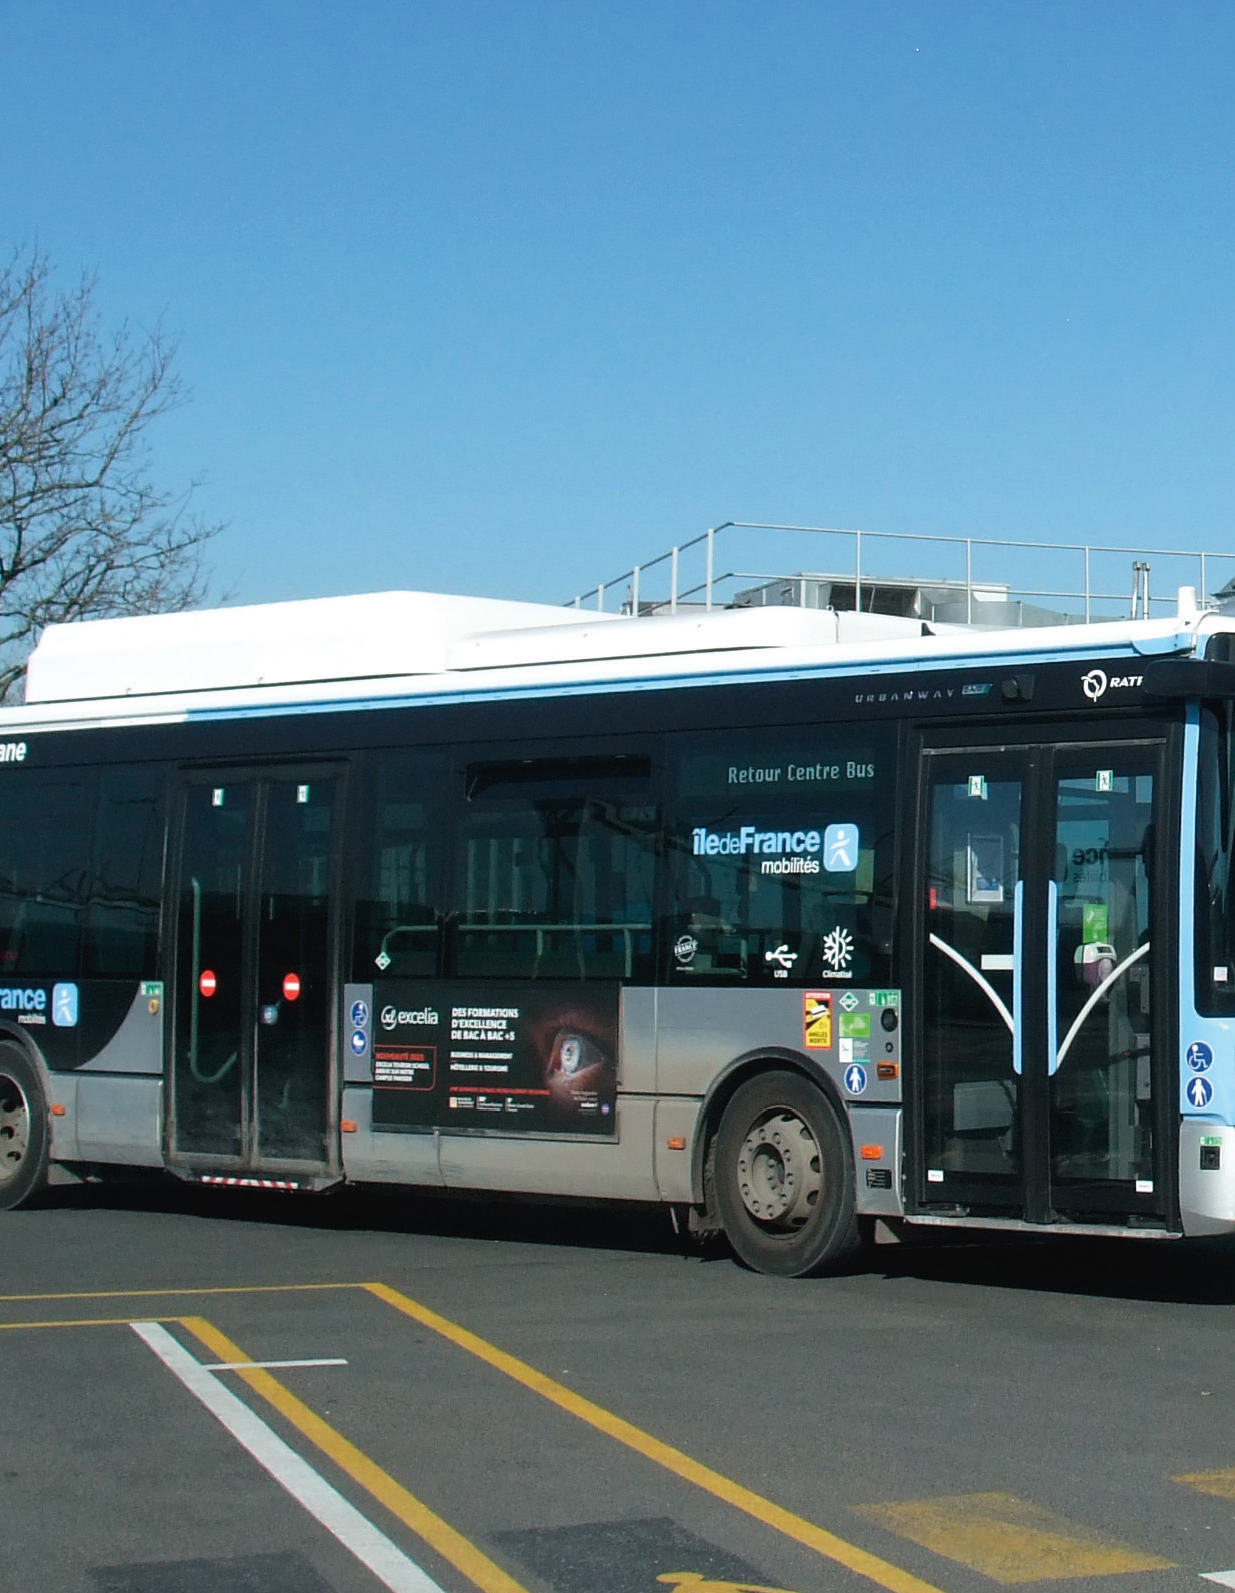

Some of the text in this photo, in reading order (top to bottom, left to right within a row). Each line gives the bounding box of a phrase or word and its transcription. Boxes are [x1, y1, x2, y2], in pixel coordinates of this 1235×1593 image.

[728, 761, 875, 784] Retour Centre Bus
[761, 856, 820, 874] mobilités
[398, 1007, 439, 1025] excelia
[451, 1007, 519, 1018] DES FORMATIONS
[451, 1019, 507, 1029] D'EXCELLENCE
[451, 1030, 462, 1040] DE
[463, 1030, 479, 1040] BAC
[487, 1031, 503, 1041] BAC
